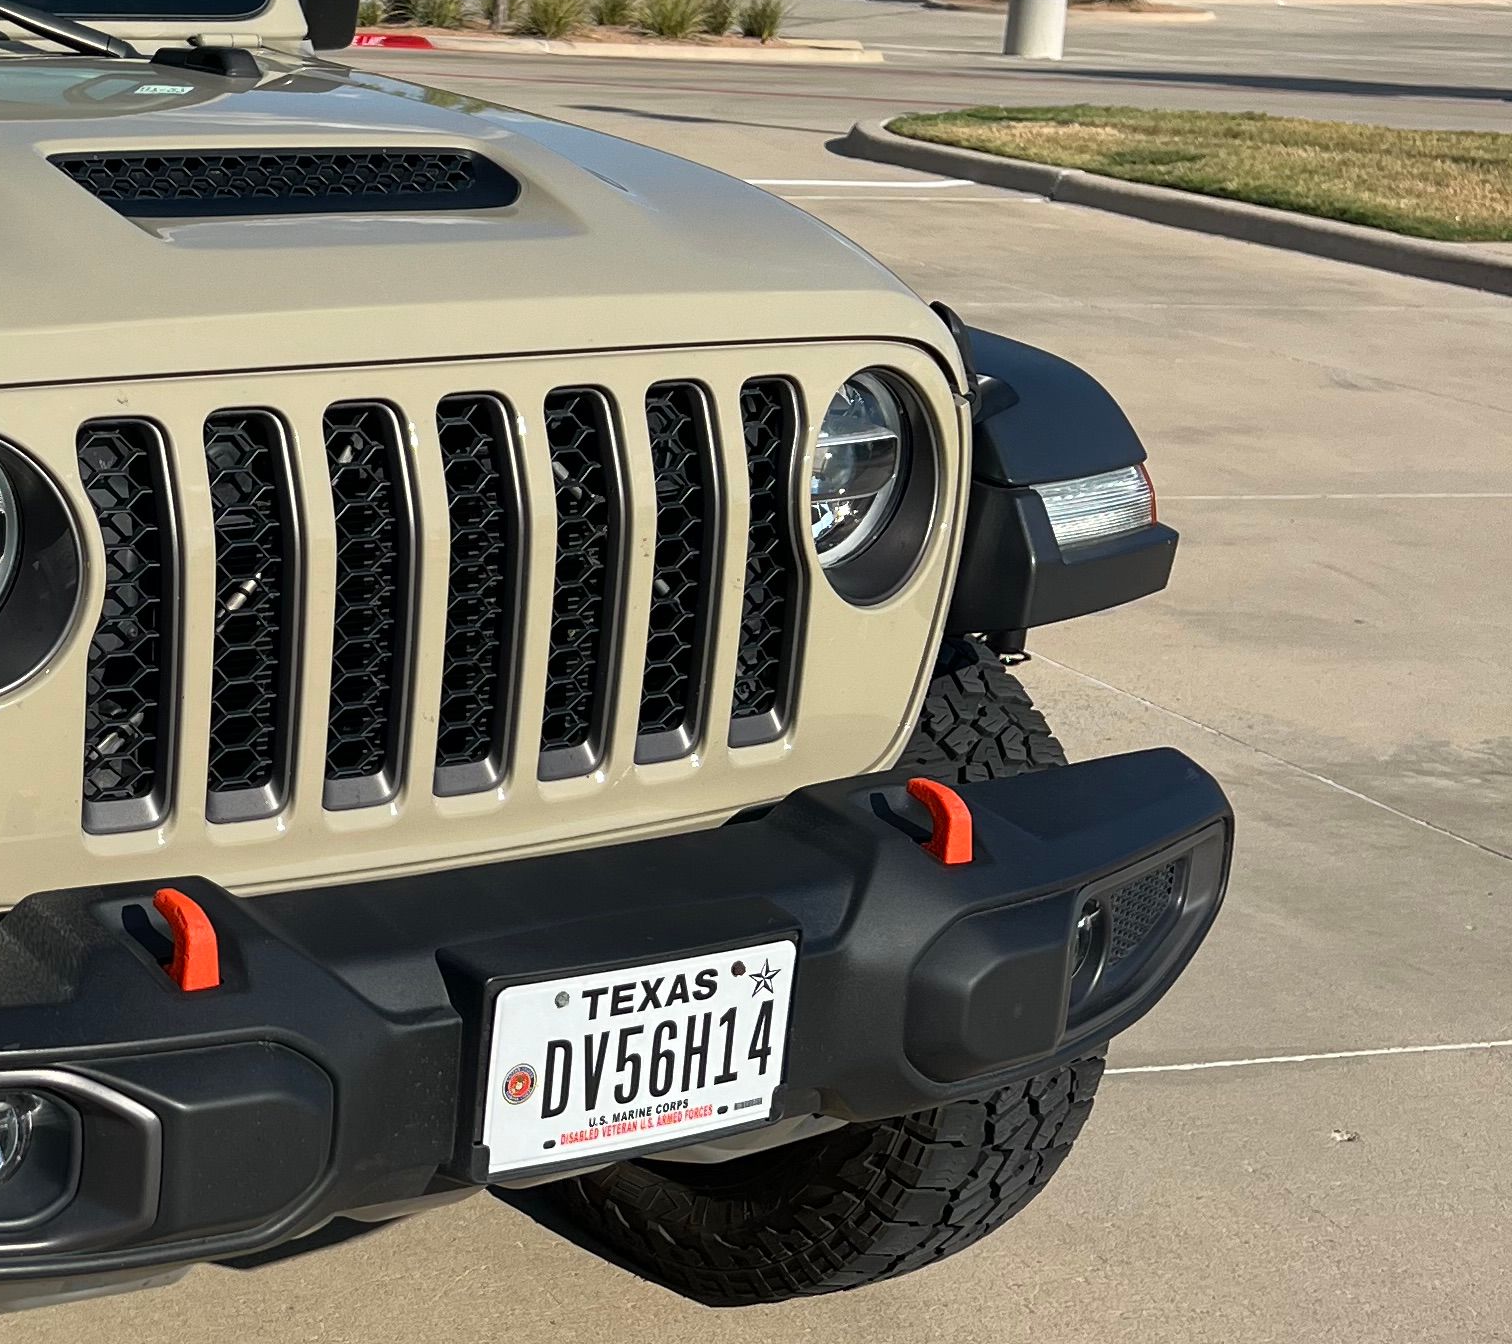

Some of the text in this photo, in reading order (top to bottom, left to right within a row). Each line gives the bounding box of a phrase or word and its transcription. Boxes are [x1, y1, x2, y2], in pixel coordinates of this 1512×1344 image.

[581, 968, 719, 1021] TEXAS
[541, 999, 775, 1119] DV56H14
[560, 1103, 713, 1145] DISABLED VETERAN U.S. ARMED FORCES
[589, 1098, 689, 1127] U.S. MARINE CORPS
